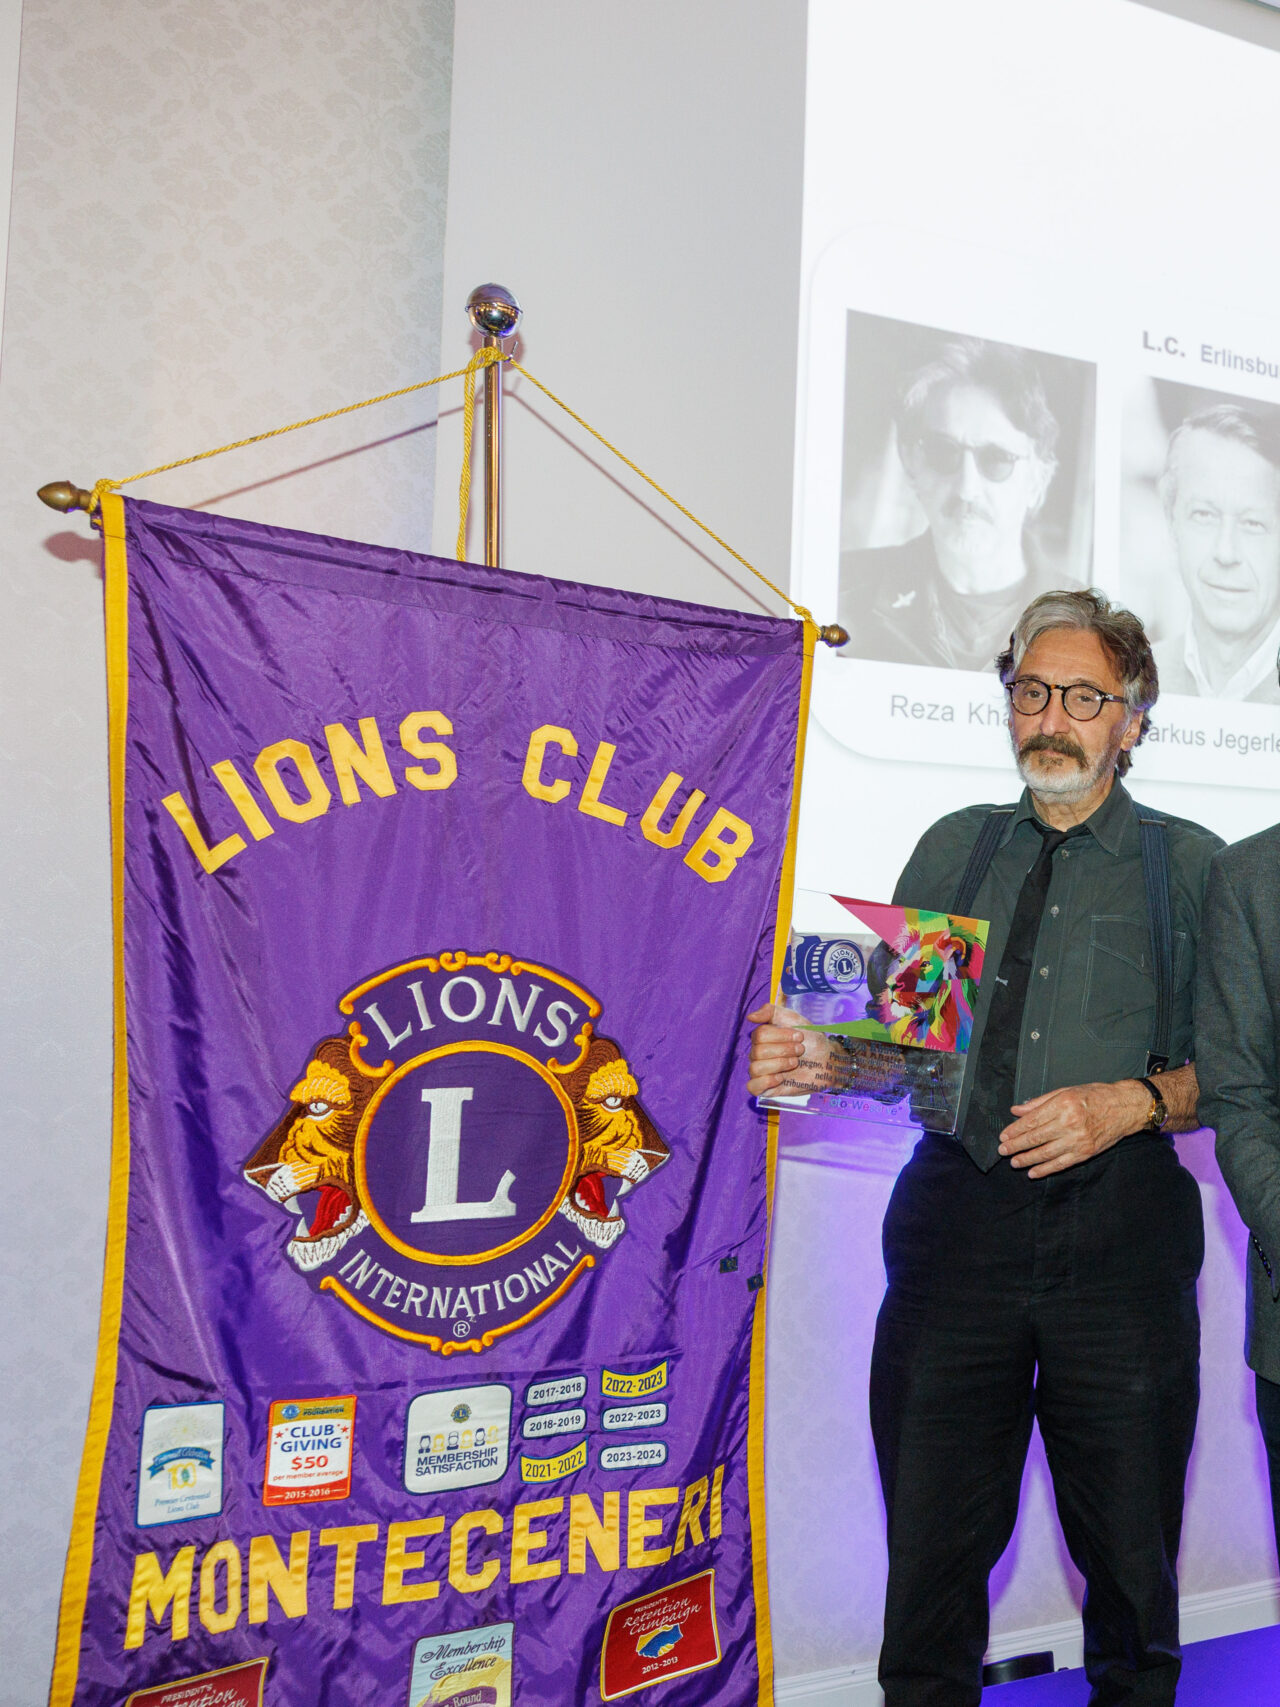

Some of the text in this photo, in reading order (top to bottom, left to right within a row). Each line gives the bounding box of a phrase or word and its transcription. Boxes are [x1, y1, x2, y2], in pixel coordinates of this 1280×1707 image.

[1142, 330, 1186, 358] L.C.
[889, 694, 1009, 727] Reza Kha
[1146, 722, 1206, 747] arkus
[162, 711, 755, 883] LIONS CLUB
[363, 976, 579, 1050] LIONS
[798, 1059, 824, 1070] pegno,
[783, 1079, 818, 1091] tribuendo
[410, 1087, 517, 1223] L
[338, 1240, 582, 1319] INTERNATIONAL
[533, 1382, 582, 1399] 2017-2018
[605, 1370, 663, 1393] 2022-2023
[529, 1415, 581, 1432] 2018-2019
[609, 1409, 661, 1424] 2022-2023
[290, 1424, 335, 1438] CLUB
[280, 1437, 342, 1452] GIVING
[291, 1455, 329, 1471] $50
[416, 1456, 498, 1476] SATISFACTION
[417, 1447, 498, 1466] MEMBERSHIP
[525, 1450, 584, 1477] 2021-2022
[607, 1449, 662, 1463] 2023-2024
[286, 1472, 315, 1480] member
[285, 1488, 331, 1500] 2015-2016
[124, 1464, 725, 1650] MONTECENERI
[622, 1597, 692, 1628] Retention
[629, 1603, 703, 1635] Campaign
[420, 1635, 506, 1663] Membership
[430, 1657, 497, 1680] Excellence
[641, 1656, 679, 1675] 2012-2013
